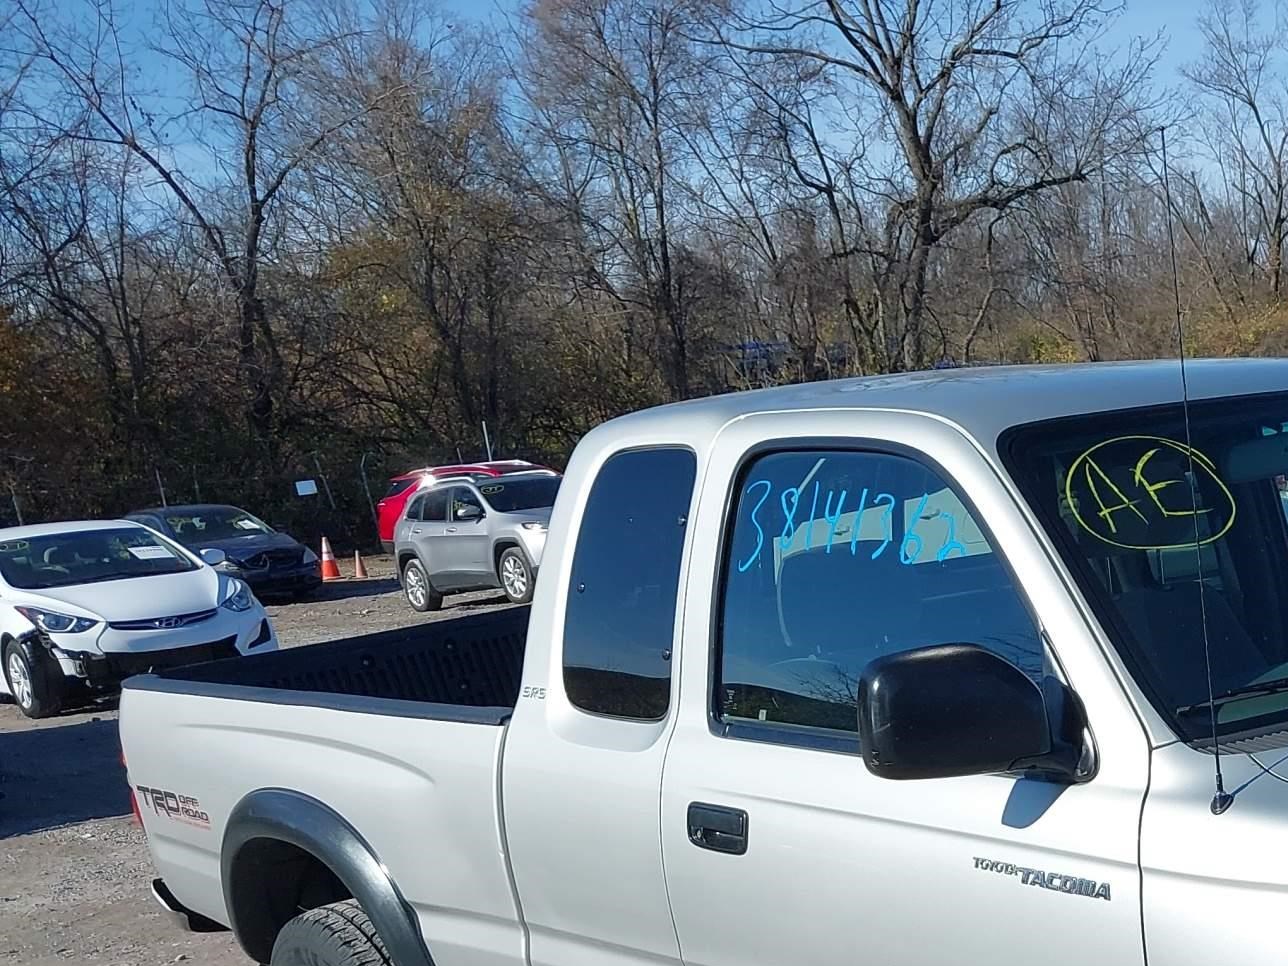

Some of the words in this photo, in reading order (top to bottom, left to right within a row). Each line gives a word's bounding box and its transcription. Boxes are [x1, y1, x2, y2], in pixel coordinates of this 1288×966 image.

[1084, 447, 1213, 533] AE
[738, 480, 966, 573] 38141362
[136, 784, 181, 818] TRD
[973, 856, 1018, 876] TOYOTA
[1016, 866, 1112, 901] TACOMA
